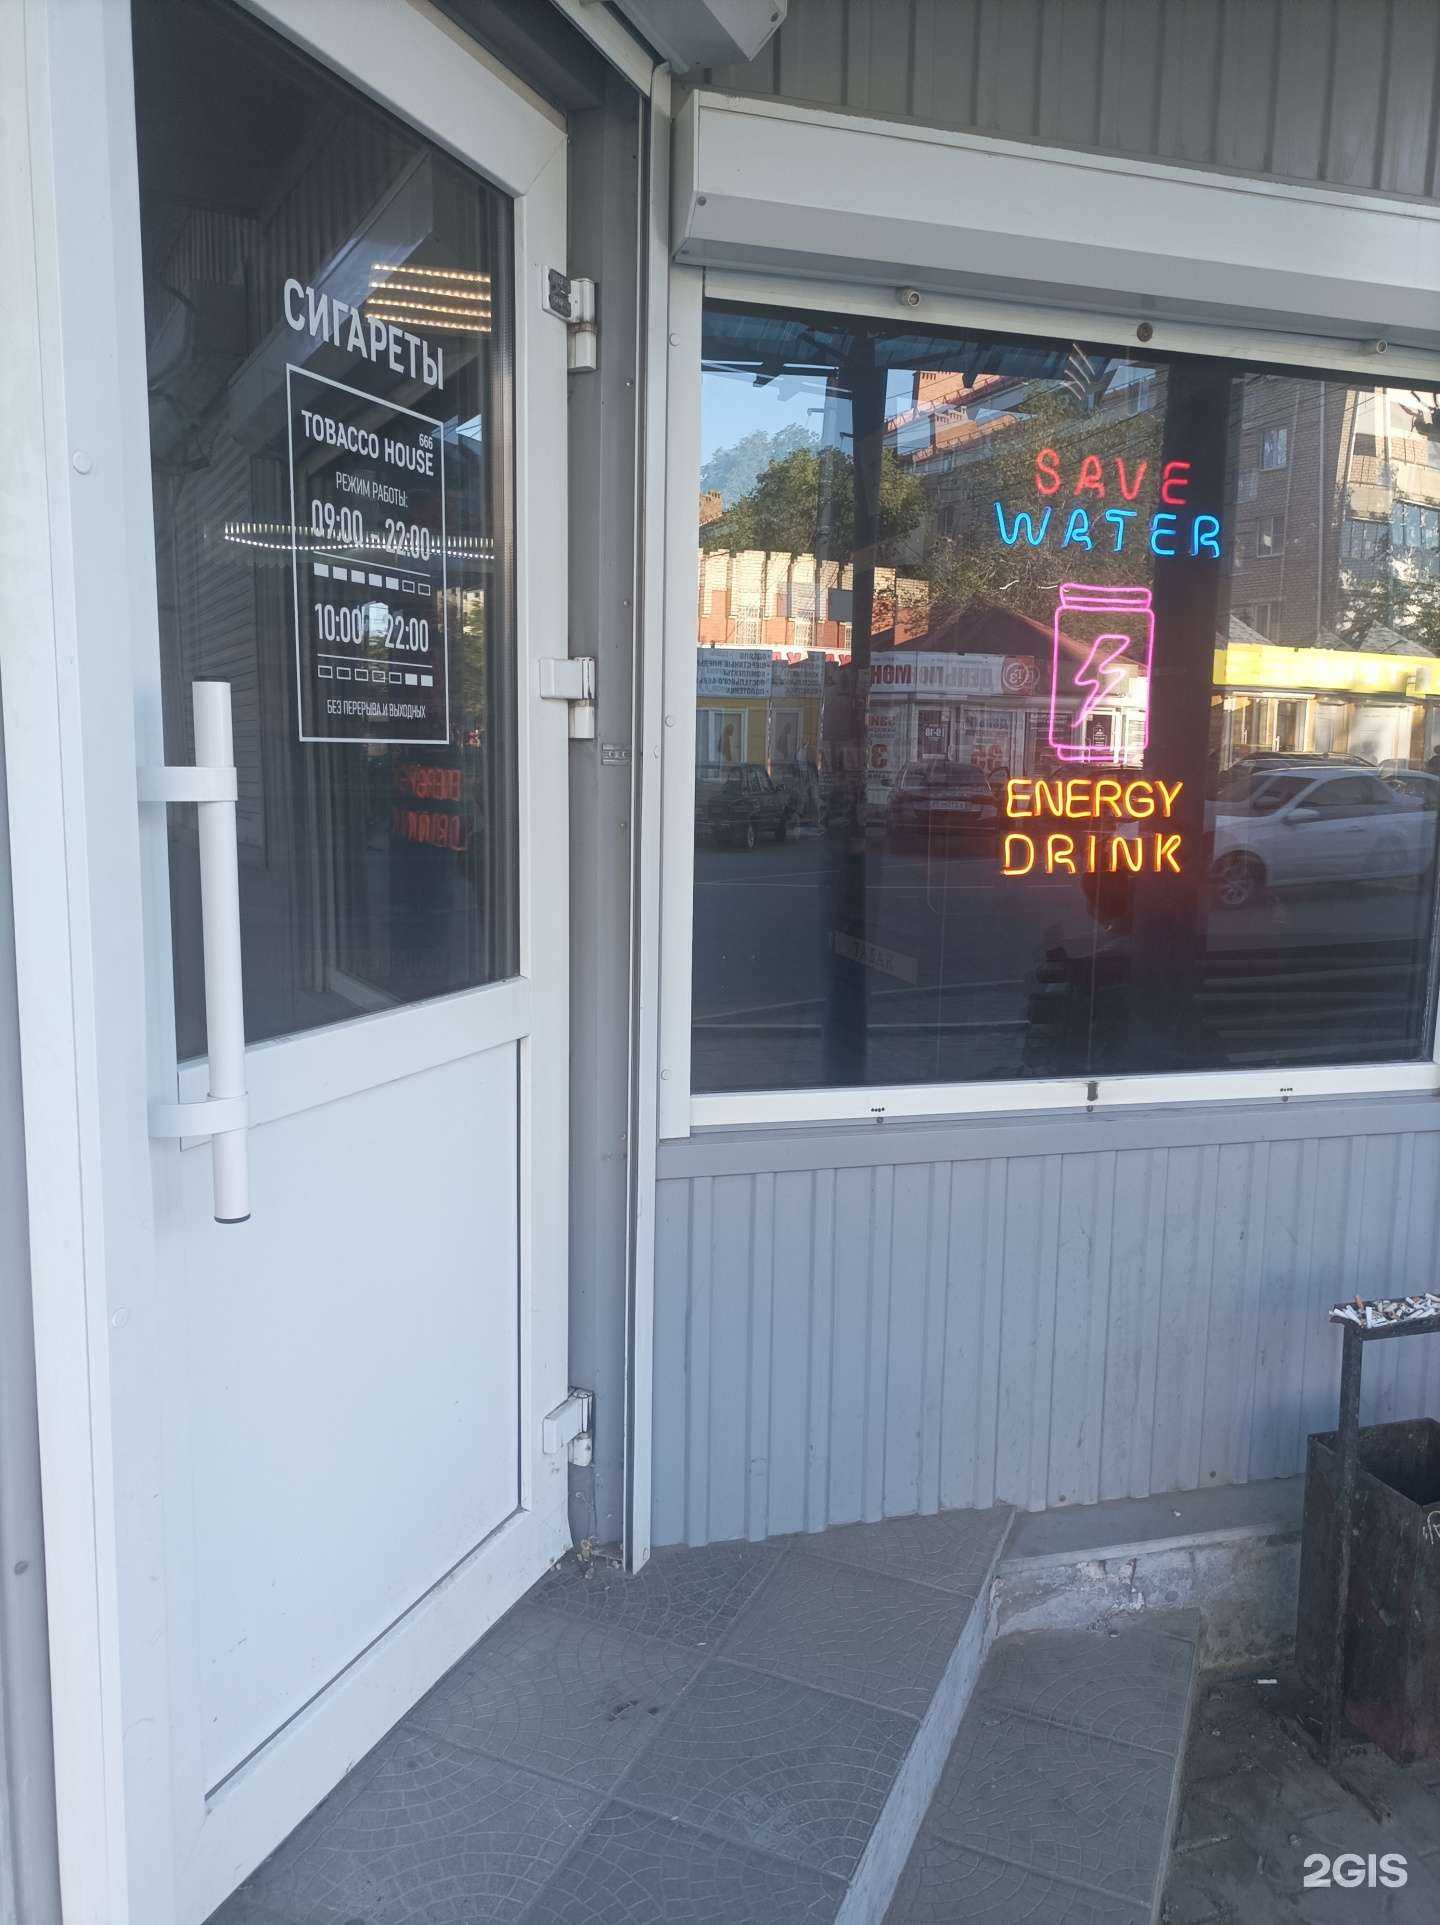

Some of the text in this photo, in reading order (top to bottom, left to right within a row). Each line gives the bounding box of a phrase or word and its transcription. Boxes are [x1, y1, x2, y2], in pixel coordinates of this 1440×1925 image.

[283, 278, 444, 390] СИГАРЕТЫ
[301, 409, 434, 476] TOBACCO HOUSE
[418, 433, 434, 450] 666
[335, 471, 409, 508] РЕЖИМ РАБОТЫ:
[1035, 448, 1192, 505] SAVE
[311, 499, 364, 546] 09:00
[385, 518, 430, 561] 22:00
[993, 501, 1223, 559] WATER
[314, 603, 429, 653] 10:00 22:00
[327, 700, 341, 714] БЕЗ
[343, 700, 381, 716] ПЕРЕРЫВА
[389, 703, 426, 720] ВЫХОДНЫХ
[1006, 778, 1185, 818] ENERGY
[1002, 832, 1183, 877] DRINK
